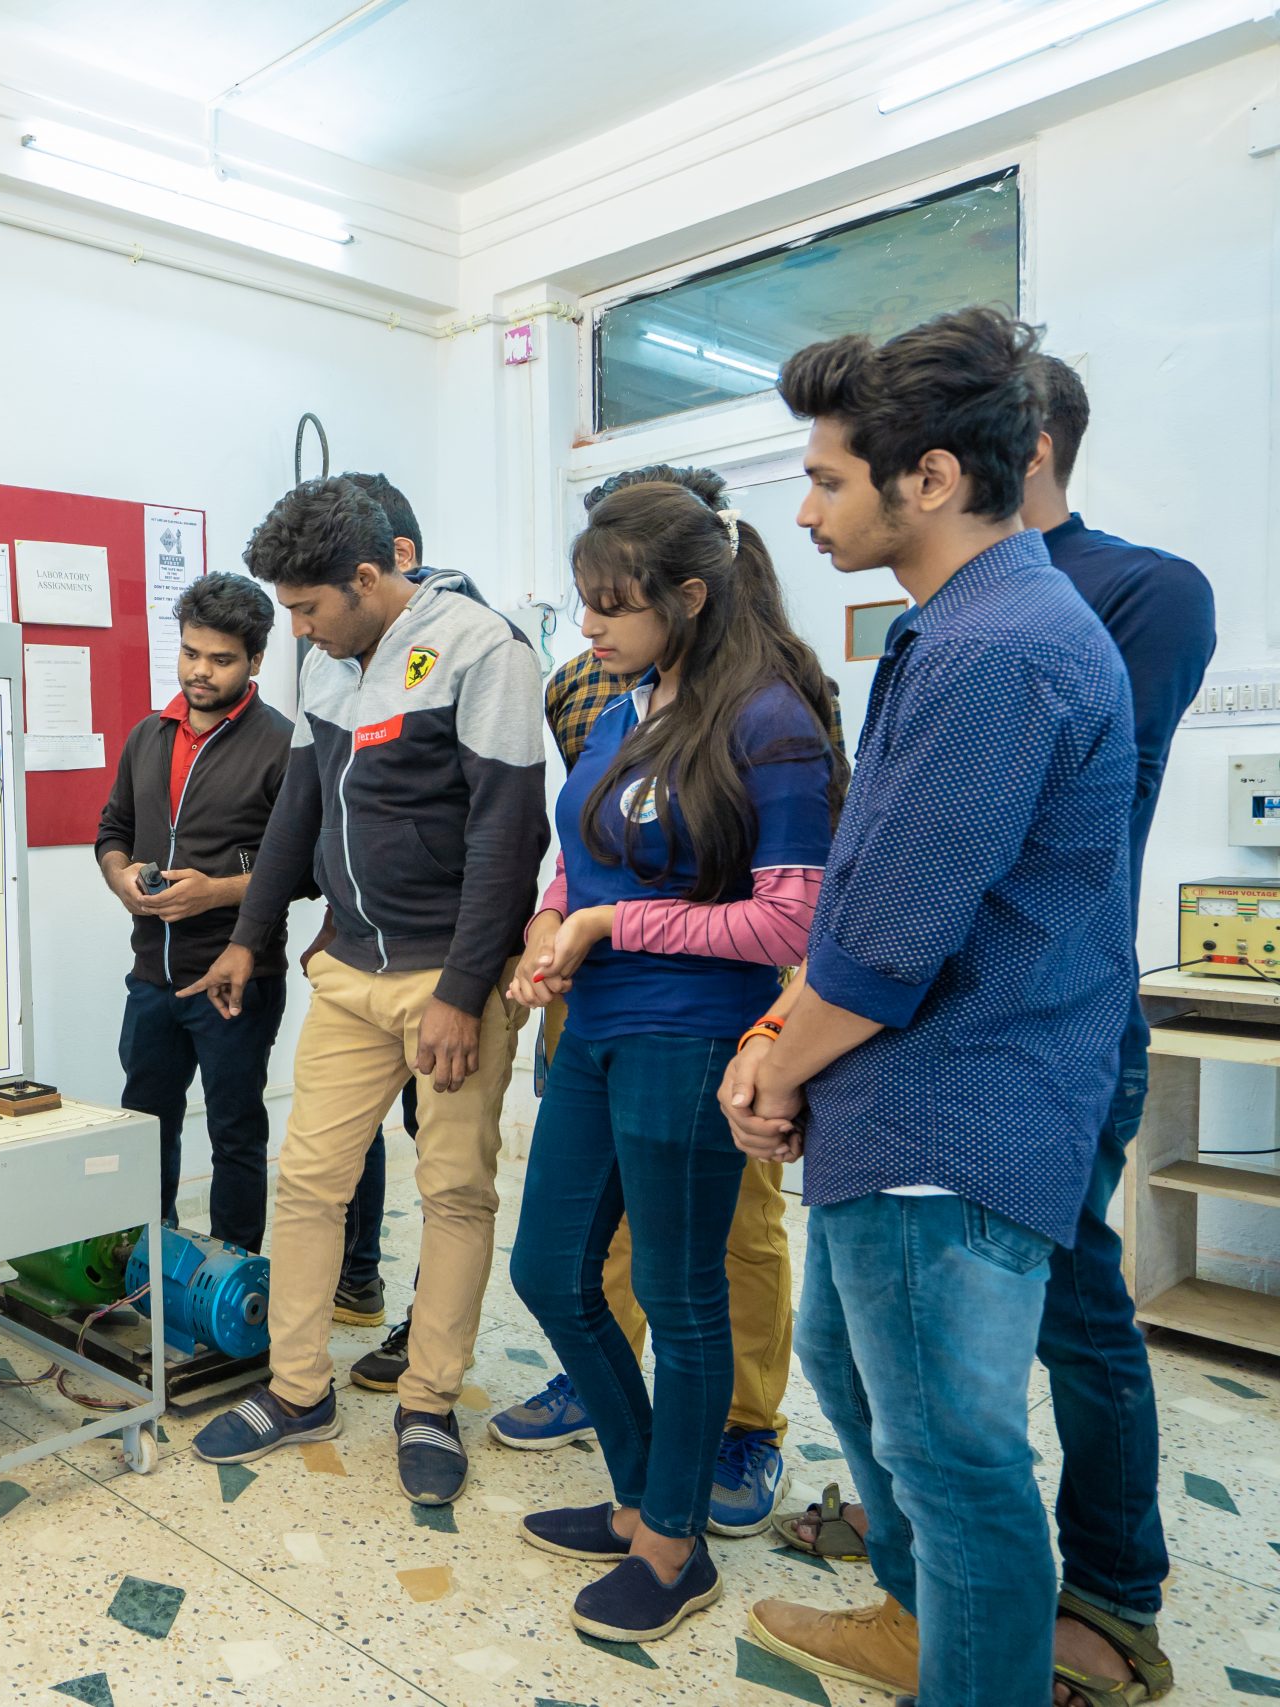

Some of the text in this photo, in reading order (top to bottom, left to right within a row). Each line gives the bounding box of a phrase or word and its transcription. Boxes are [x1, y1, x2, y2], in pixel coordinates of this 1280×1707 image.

[36, 569, 90, 581] LABORATORY
[38, 581, 93, 592] ASSIGNMENTS
[357, 727, 387, 743] Ferrari
